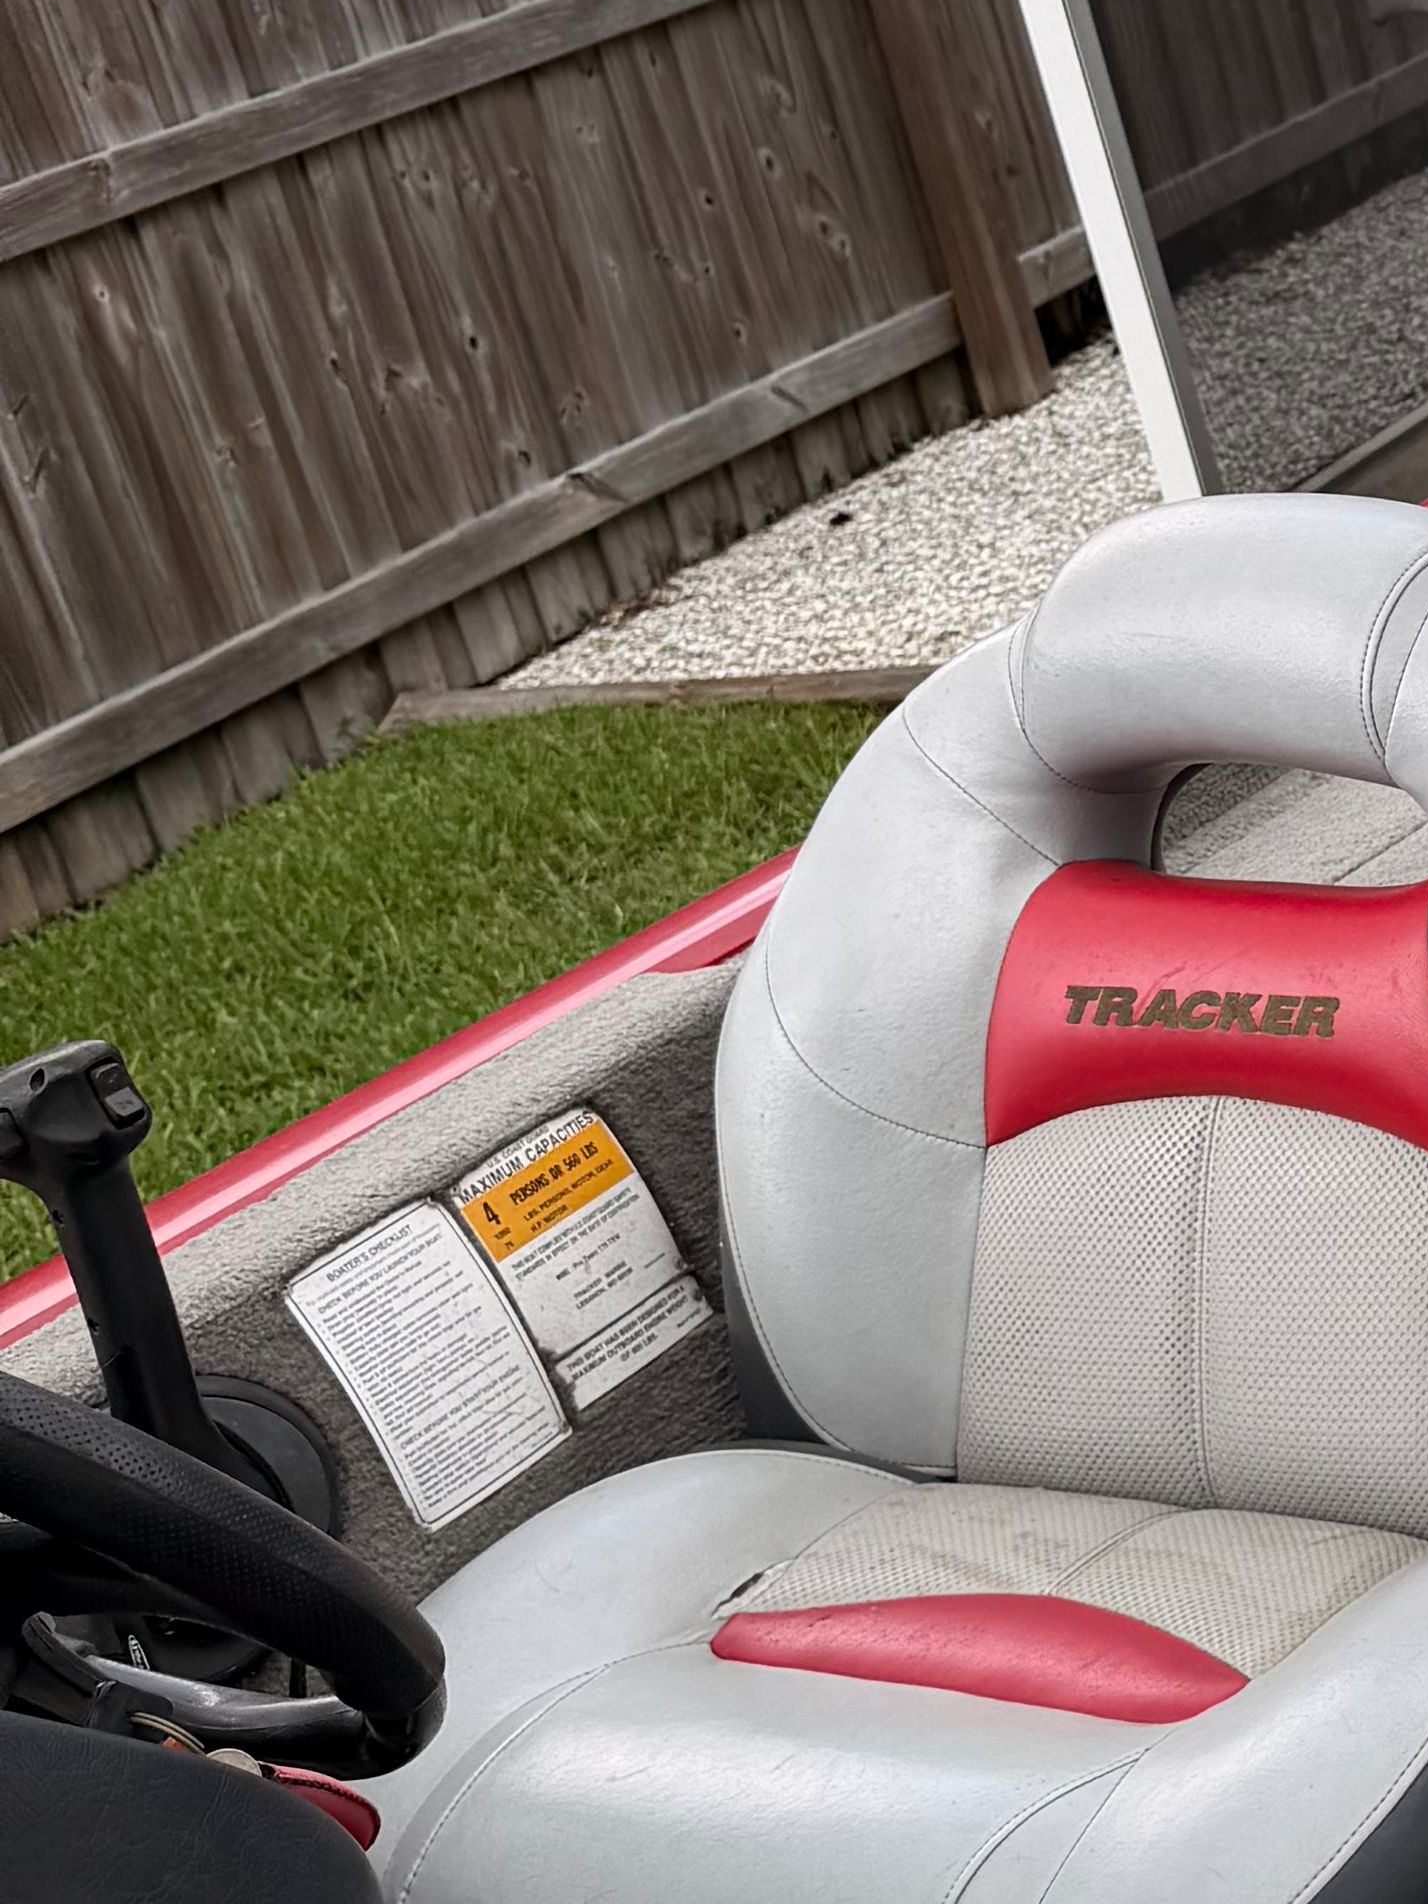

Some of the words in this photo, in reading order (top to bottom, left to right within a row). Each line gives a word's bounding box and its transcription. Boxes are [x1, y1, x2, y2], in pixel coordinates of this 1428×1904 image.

[1065, 984, 1341, 1039] TRACKER
[458, 1157, 523, 1204] MAXIMUM
[525, 1110, 593, 1161] CAPACITIES
[510, 1174, 549, 1205] PERSONS
[549, 1165, 564, 1180] OR
[580, 1142, 598, 1159] LBS
[483, 1202, 501, 1225] 4
[327, 1252, 369, 1282] BOATER'S
[368, 1225, 412, 1256] CHECKLIST
